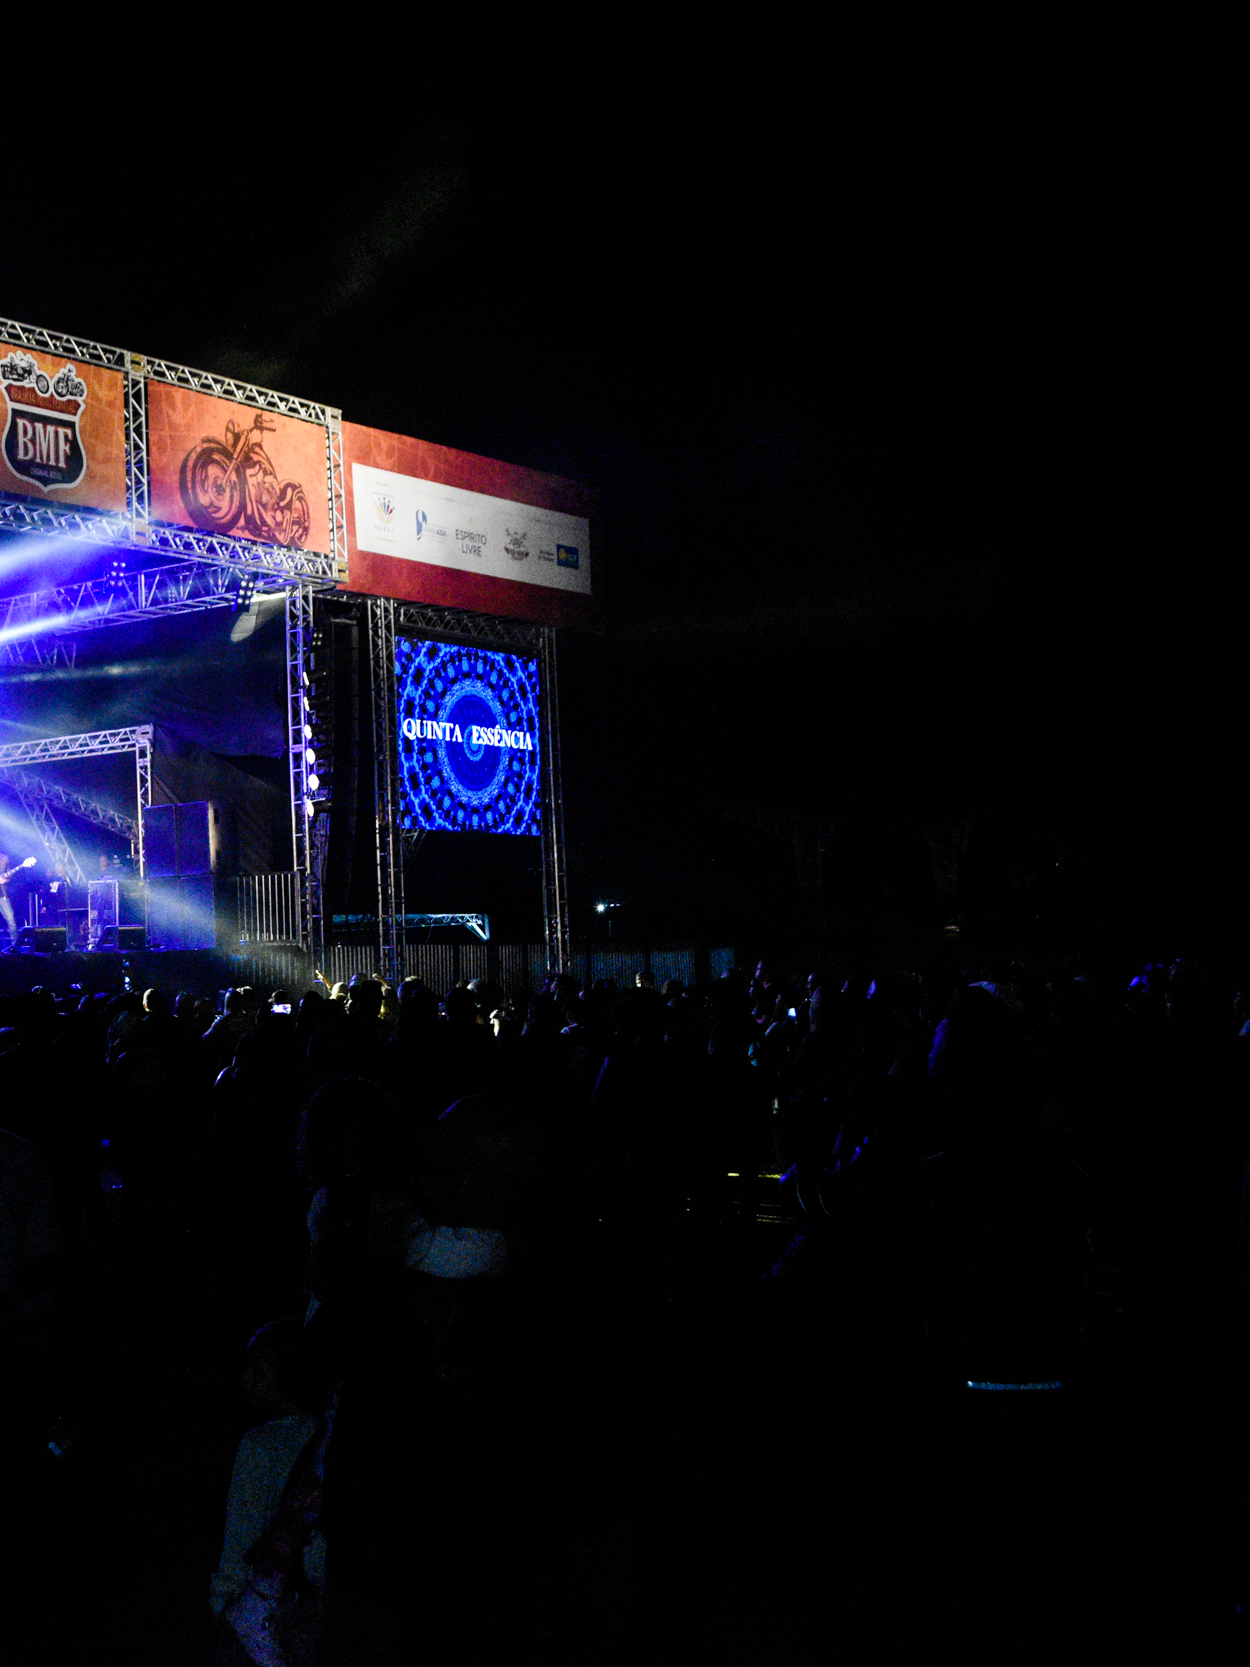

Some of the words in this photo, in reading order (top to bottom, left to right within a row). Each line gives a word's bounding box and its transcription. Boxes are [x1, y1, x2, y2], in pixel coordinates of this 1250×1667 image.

[16, 418, 73, 468] BMF
[455, 528, 487, 546] ESPÍRITO
[461, 543, 482, 557] LIVRE
[403, 718, 463, 743] QUINTA
[471, 724, 533, 751] ESSÊNCIA
